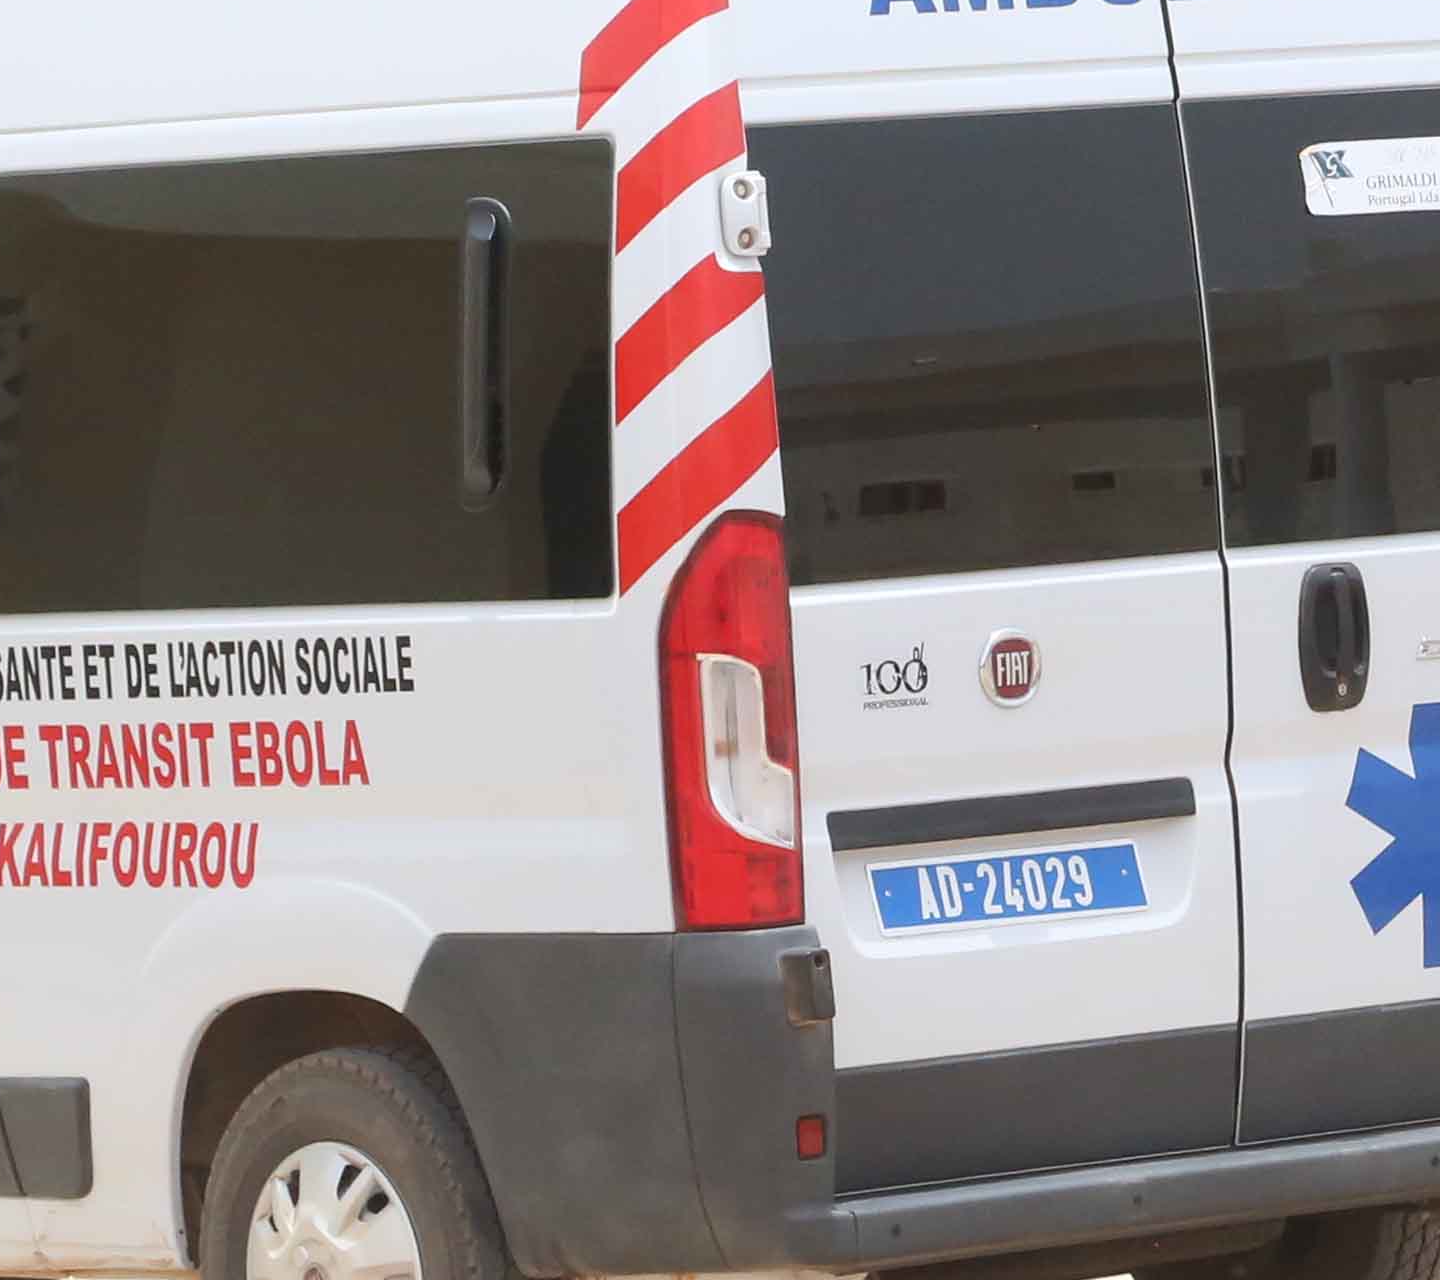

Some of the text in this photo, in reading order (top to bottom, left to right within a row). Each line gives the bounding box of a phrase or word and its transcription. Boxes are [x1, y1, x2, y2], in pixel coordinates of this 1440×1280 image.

[1366, 172, 1438, 190] GRIMALDI
[1367, 192, 1416, 206] Portugal
[82, 644, 115, 700] ET
[124, 643, 161, 699] DE
[167, 639, 287, 698] L'ACTION
[295, 635, 415, 695] SOCIALE
[996, 650, 1030, 688] FIAT
[38, 722, 215, 789] TRANSIT
[229, 719, 369, 788] EBOLA
[917, 855, 1094, 920] AD-24029
